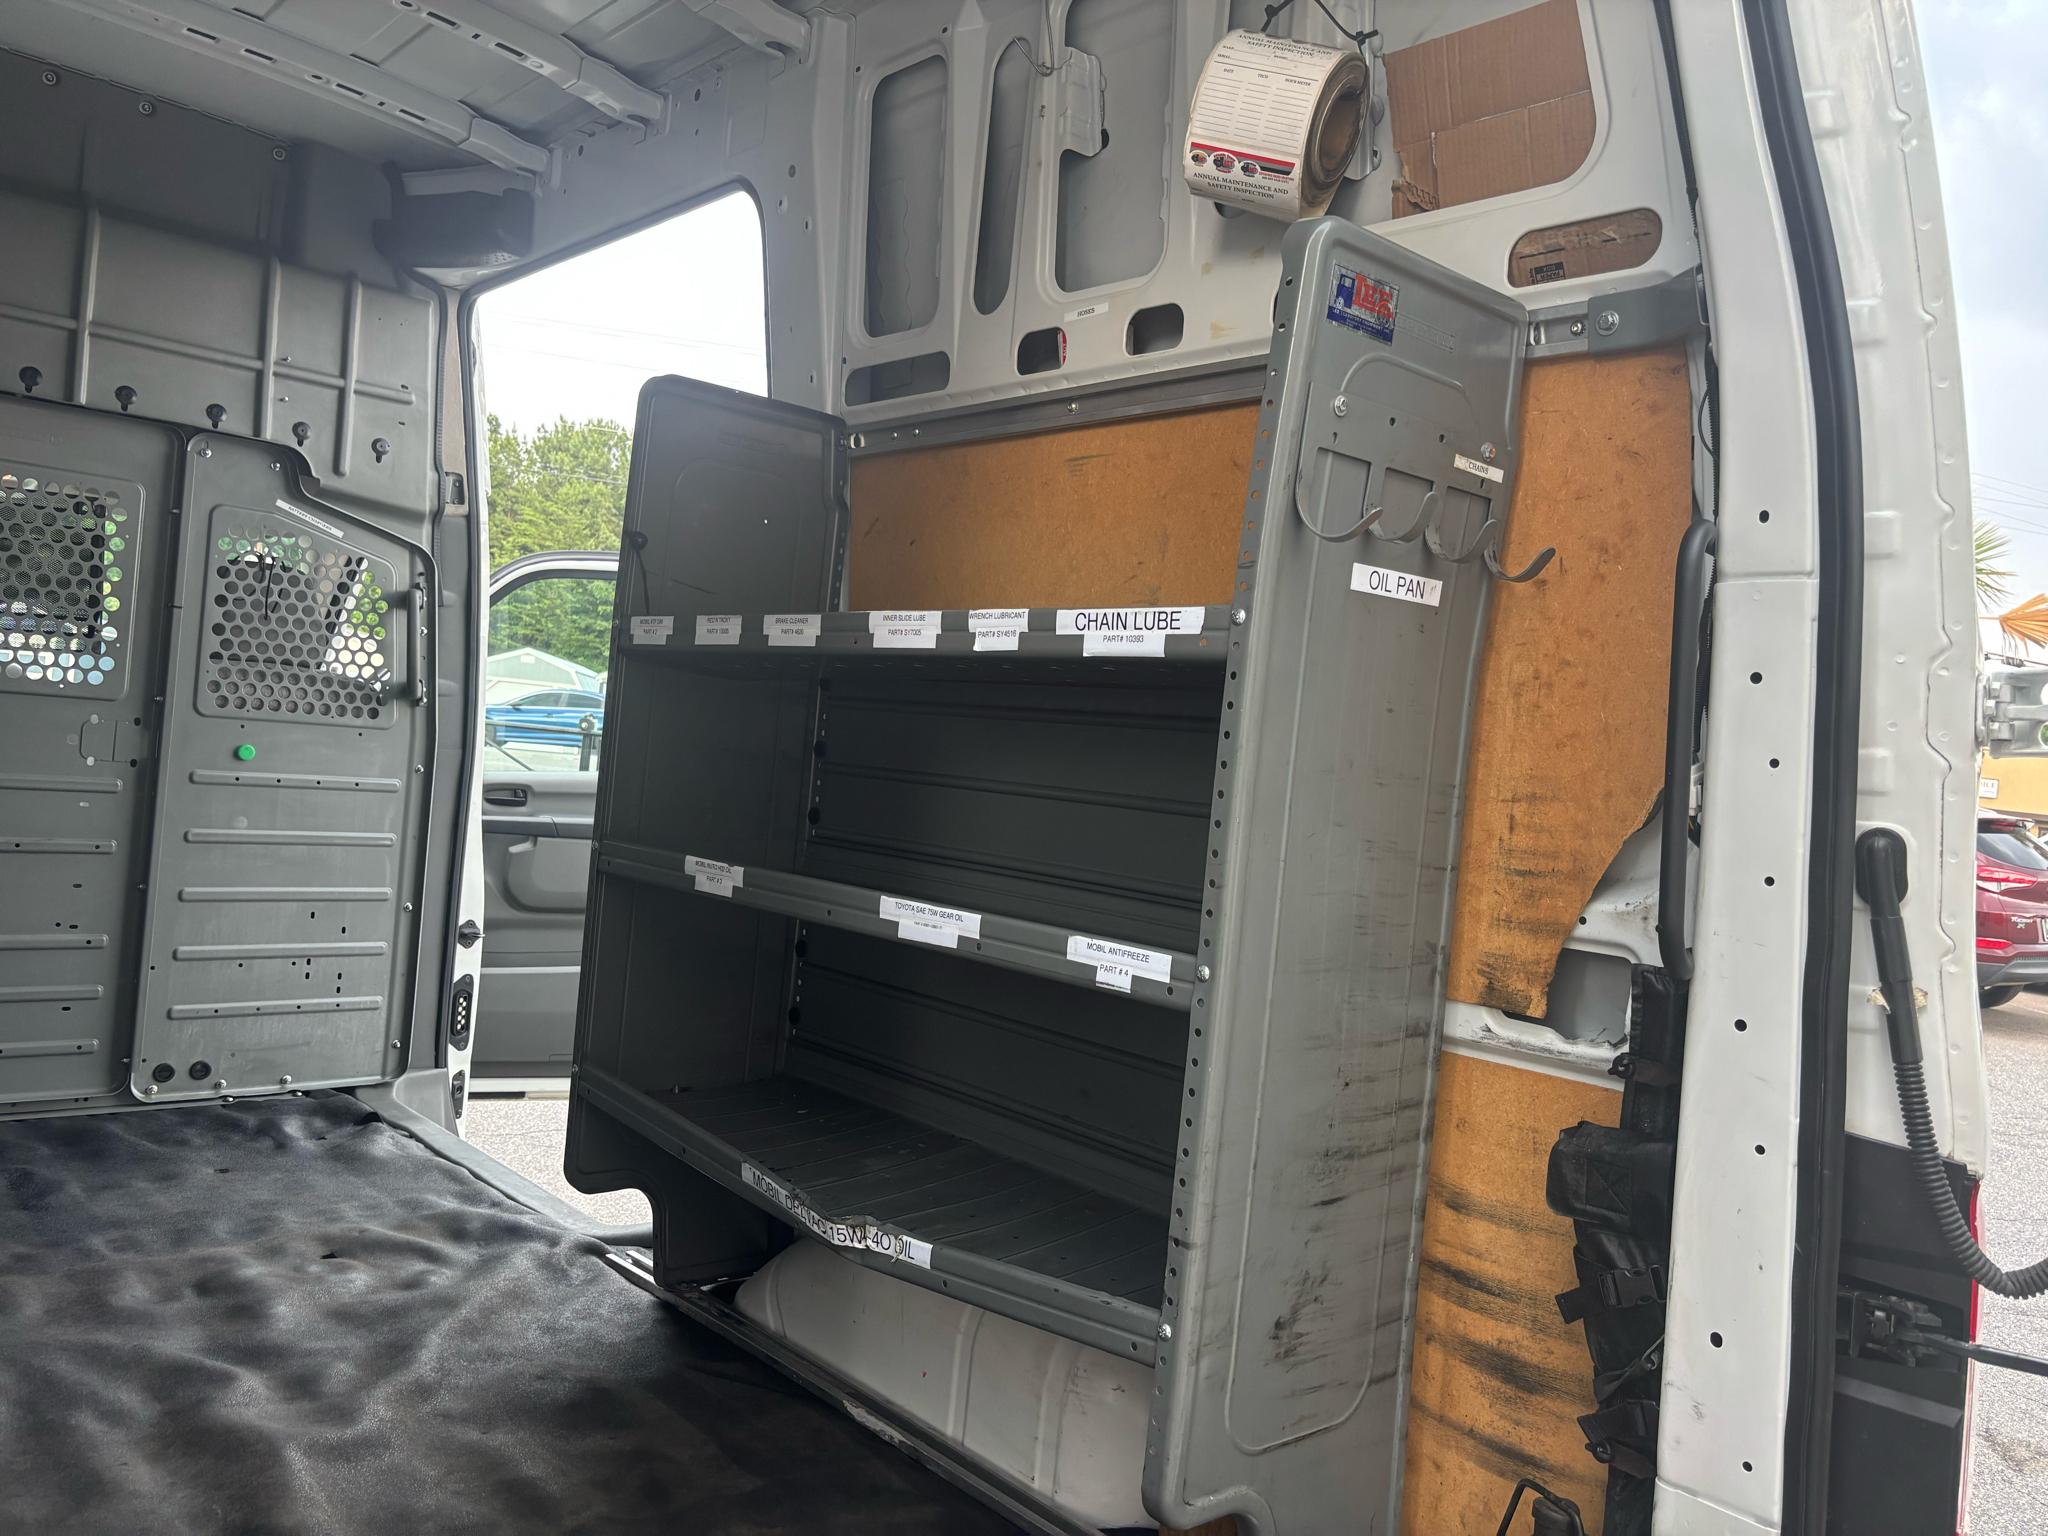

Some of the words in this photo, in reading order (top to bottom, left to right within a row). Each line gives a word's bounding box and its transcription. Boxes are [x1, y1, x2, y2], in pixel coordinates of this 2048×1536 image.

[1193, 172, 1221, 182] ANNUAL
[1222, 177, 1273, 193] MAINTENANCE
[1274, 187, 1289, 195] AND
[1207, 181, 1233, 192] SAFETY
[1233, 186, 1275, 199] INSPECTION
[1468, 462, 1489, 475] CHAINS
[1369, 570, 1392, 593] OIL
[1396, 576, 1426, 600] PAN
[969, 612, 993, 620] WRENCH
[993, 611, 1026, 619] LUBRICANT
[1074, 611, 1128, 631] CHAIN
[1134, 610, 1182, 631] LUBE
[977, 630, 996, 638] PART#
[996, 630, 1017, 638] SY4516
[1102, 634, 1124, 643] PART#
[1125, 634, 1144, 643] 10393
[895, 901, 915, 912] TOYOTA
[916, 905, 927, 915] SAE
[927, 908, 938, 917] 75W
[939, 910, 954, 920] GEAR
[954, 913, 964, 923] OIL
[1086, 942, 1107, 954] MOBIL
[1108, 947, 1150, 963] ANTIFREEZE
[1100, 963, 1117, 975] PART
[752, 1171, 784, 1206] MOBIL
[895, 1237, 916, 1260] OIL
